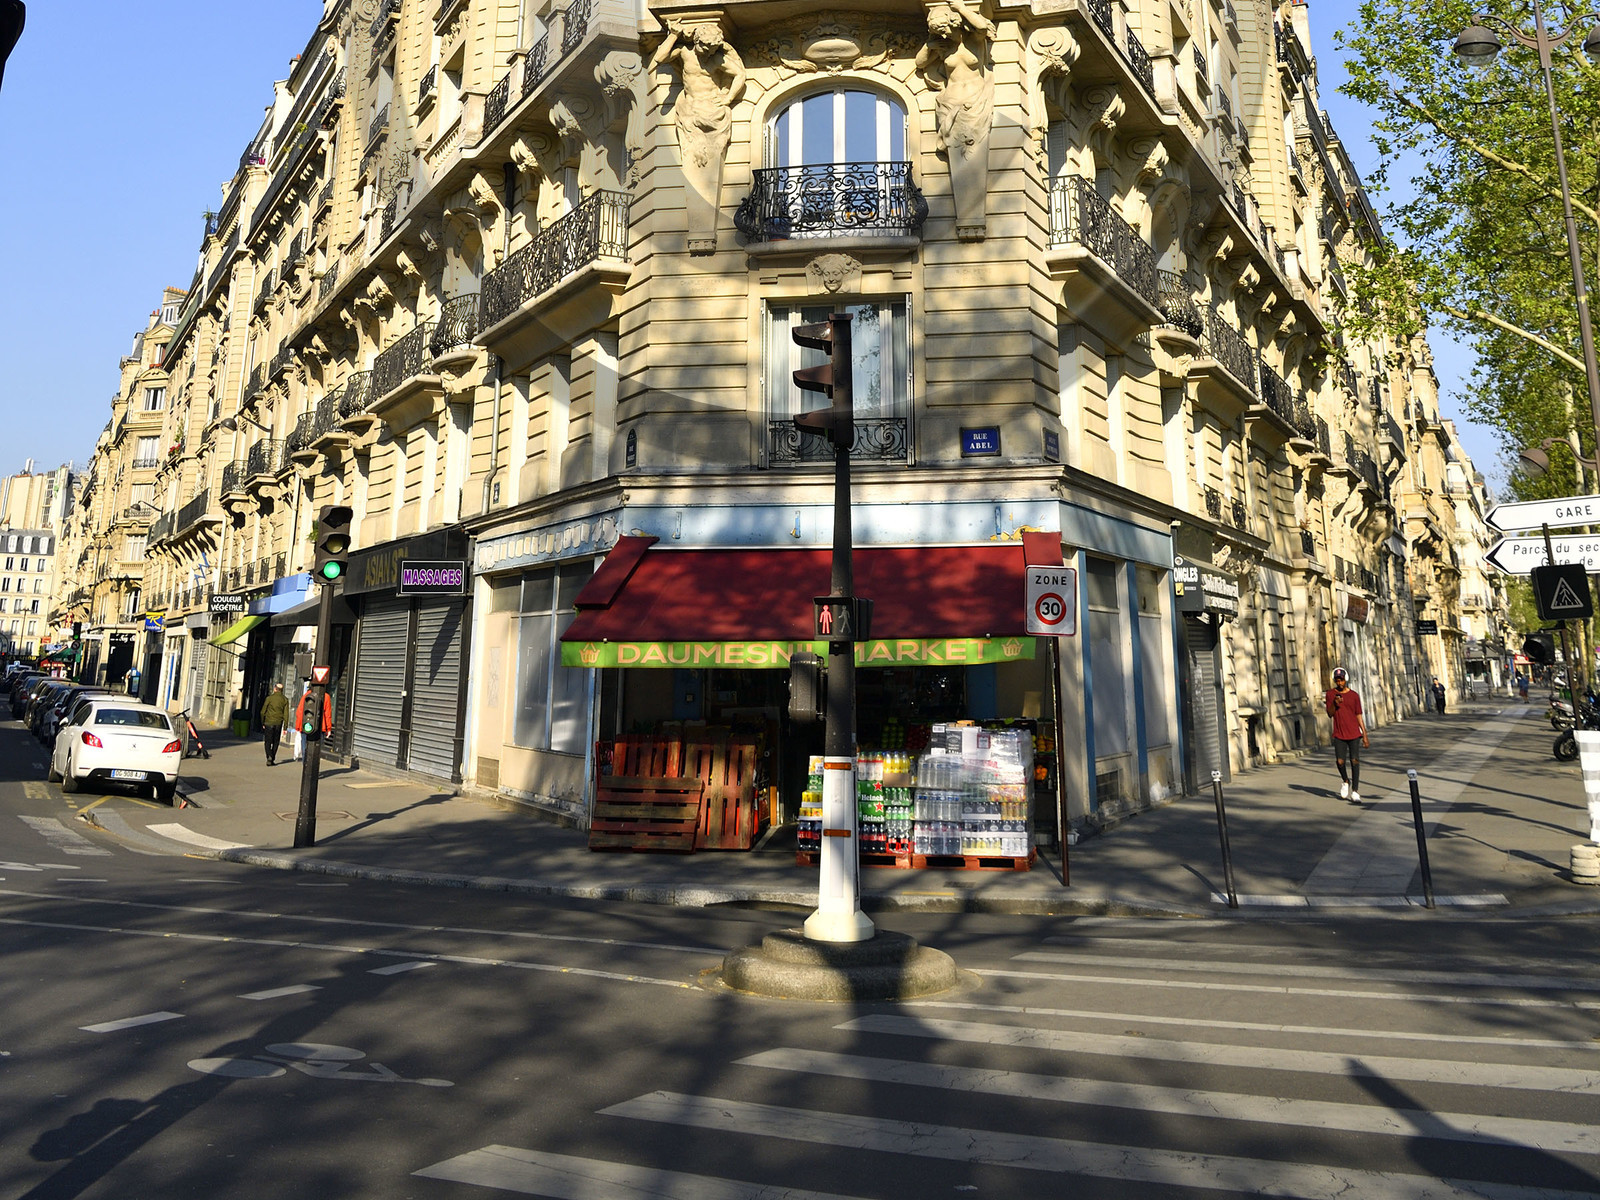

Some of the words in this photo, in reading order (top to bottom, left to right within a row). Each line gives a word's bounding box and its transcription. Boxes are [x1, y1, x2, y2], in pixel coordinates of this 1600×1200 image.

[1555, 505, 1593, 518] GARE
[1513, 544, 1548, 555] Parcs
[1556, 543, 1570, 553] du
[364, 551, 391, 588] ASIAN
[1173, 567, 1199, 582] ONGLES
[403, 569, 462, 586] MASSAGES
[1035, 575, 1067, 585] ZONE
[211, 603, 243, 611] VÉGÉTALE
[1041, 602, 1060, 616] 30
